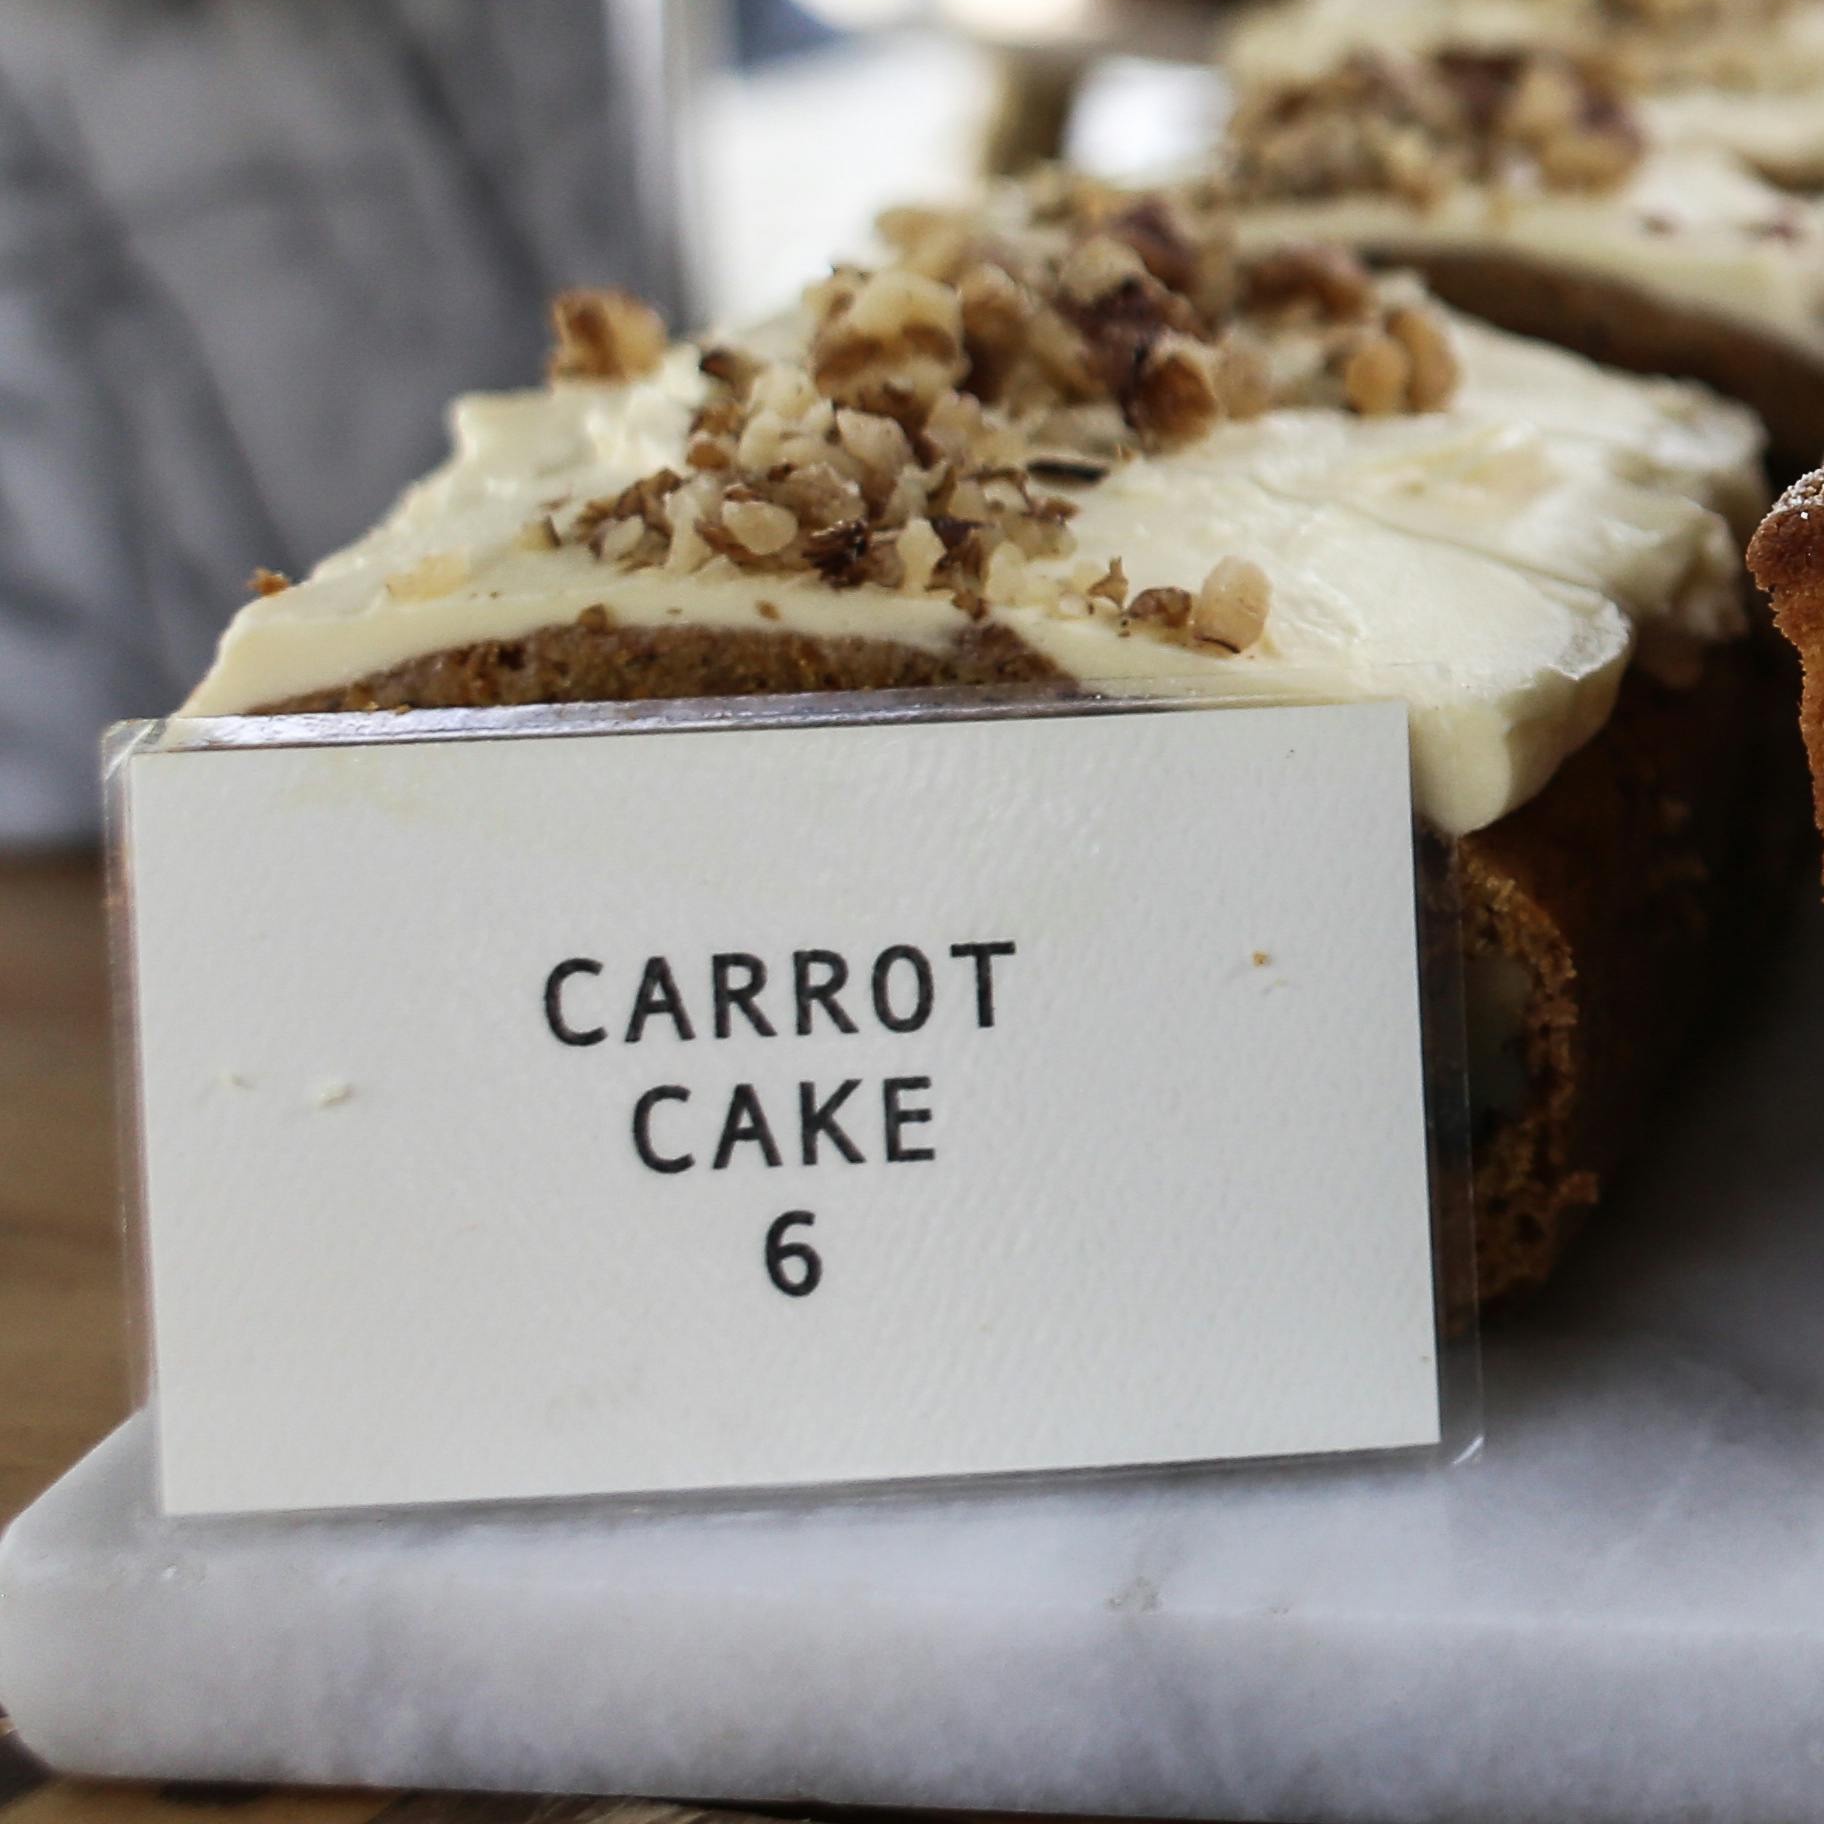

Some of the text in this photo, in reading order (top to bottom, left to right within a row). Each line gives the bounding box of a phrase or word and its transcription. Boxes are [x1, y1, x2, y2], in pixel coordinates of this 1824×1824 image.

[543, 941, 1017, 1047] CARROT
[630, 1075, 936, 1176] CAKE
[763, 1209, 823, 1299] 6
